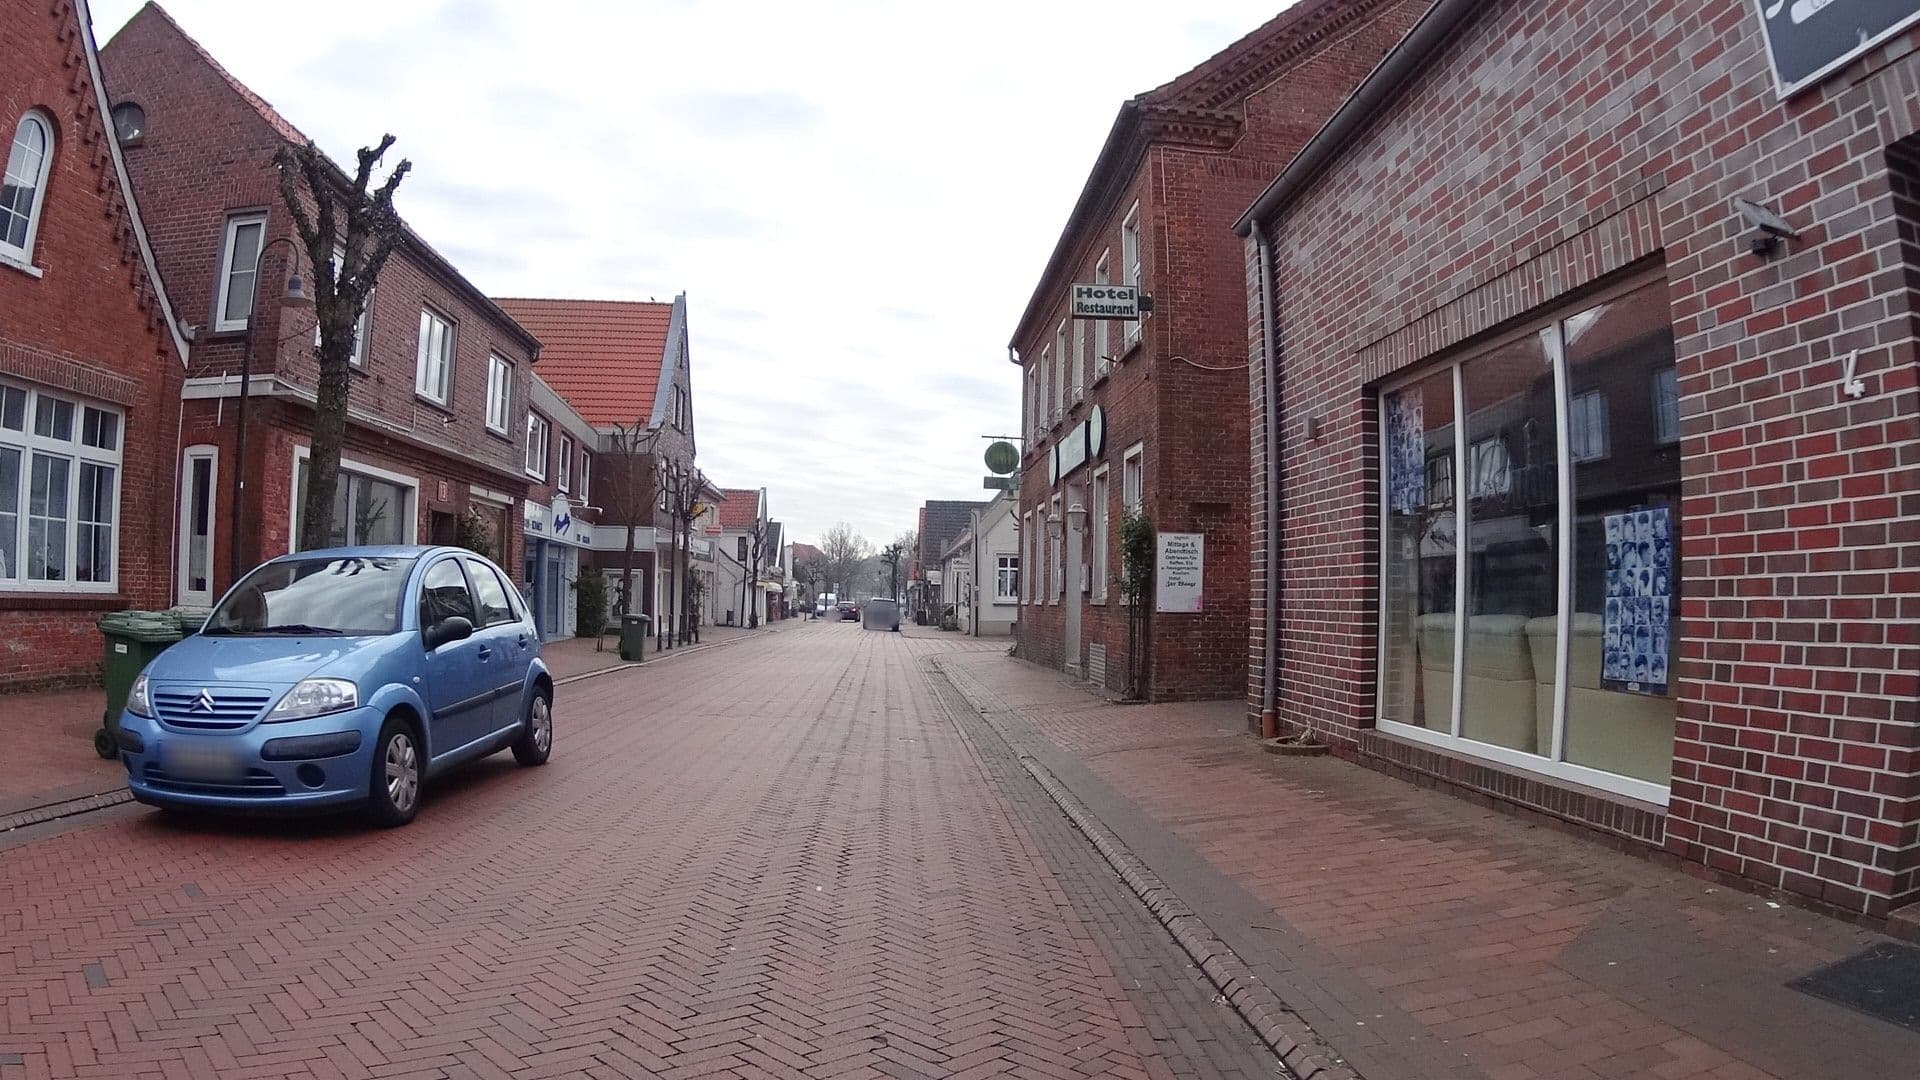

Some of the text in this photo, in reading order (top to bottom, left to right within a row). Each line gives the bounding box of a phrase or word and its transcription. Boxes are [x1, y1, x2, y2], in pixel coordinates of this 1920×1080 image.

[1076, 287, 1134, 300] Hotel
[1076, 302, 1135, 314] Restaurant
[1843, 349, 1865, 399] 4
